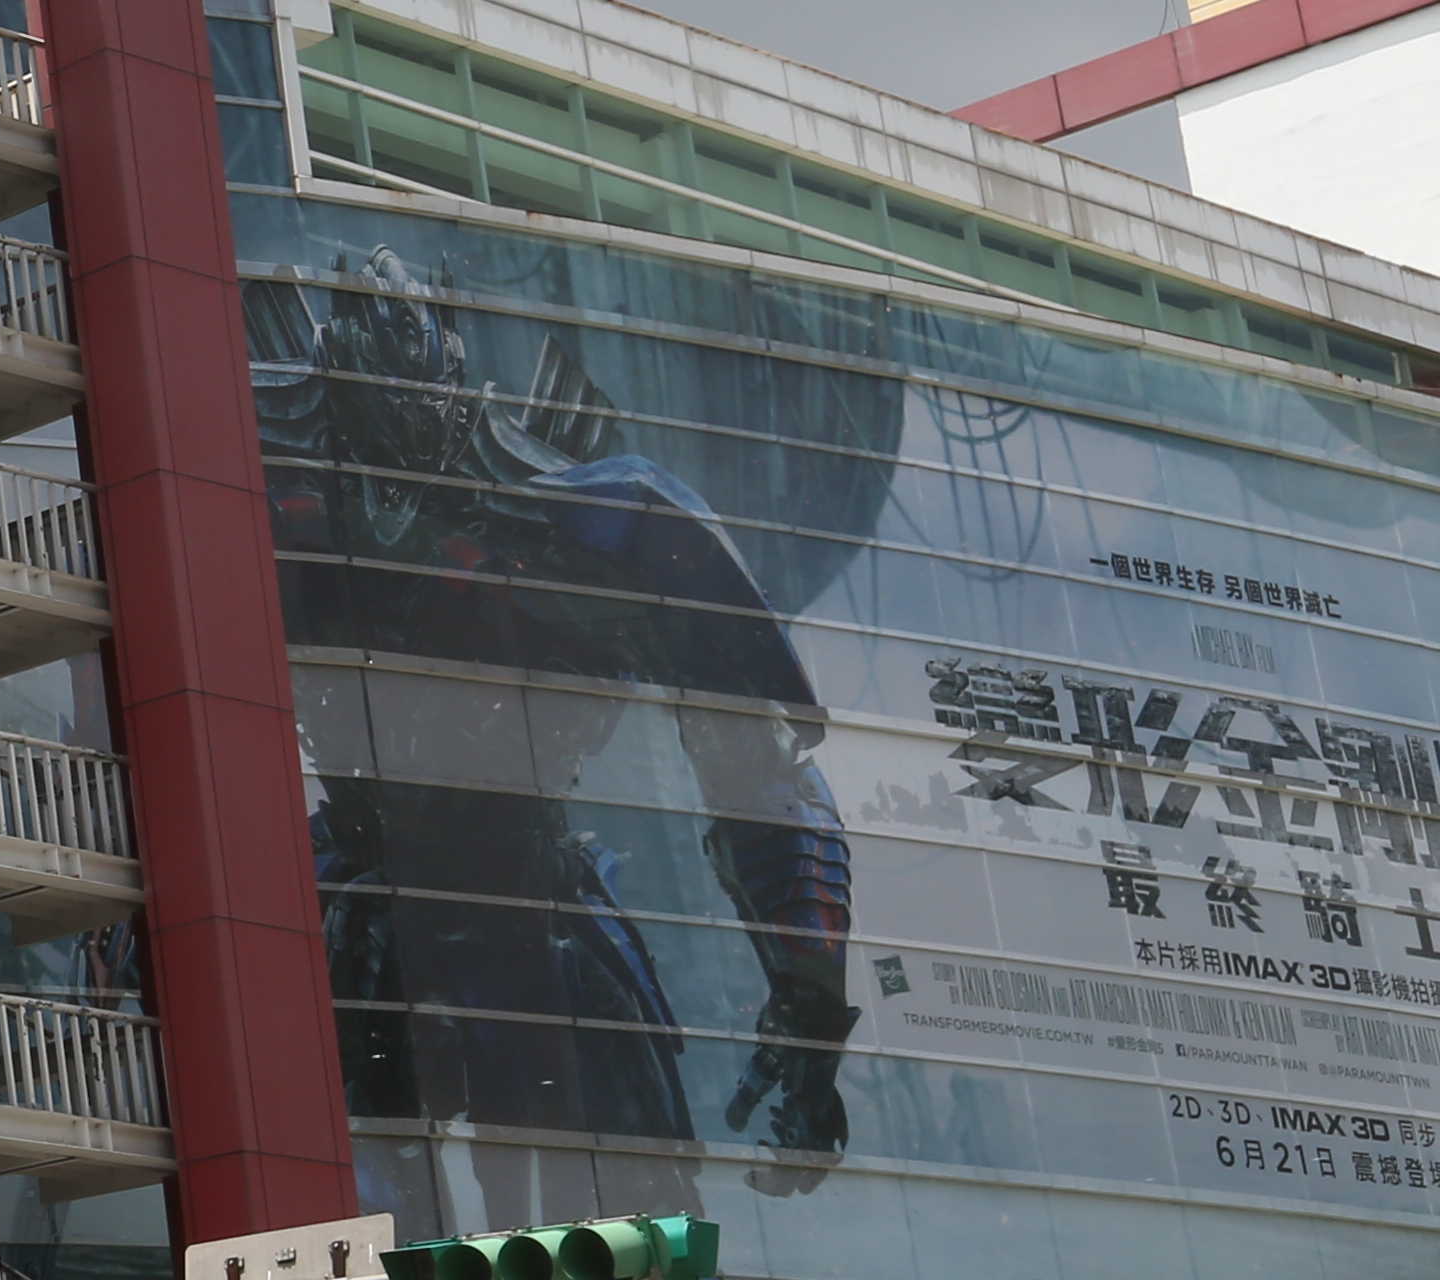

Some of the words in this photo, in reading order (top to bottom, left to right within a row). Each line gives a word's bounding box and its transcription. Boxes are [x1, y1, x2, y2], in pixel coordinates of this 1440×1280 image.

[1090, 552, 1216, 594] 一個世界生存
[1224, 574, 1342, 620] 另個世界滅亡
[1100, 839, 1440, 961] 最終騎士
